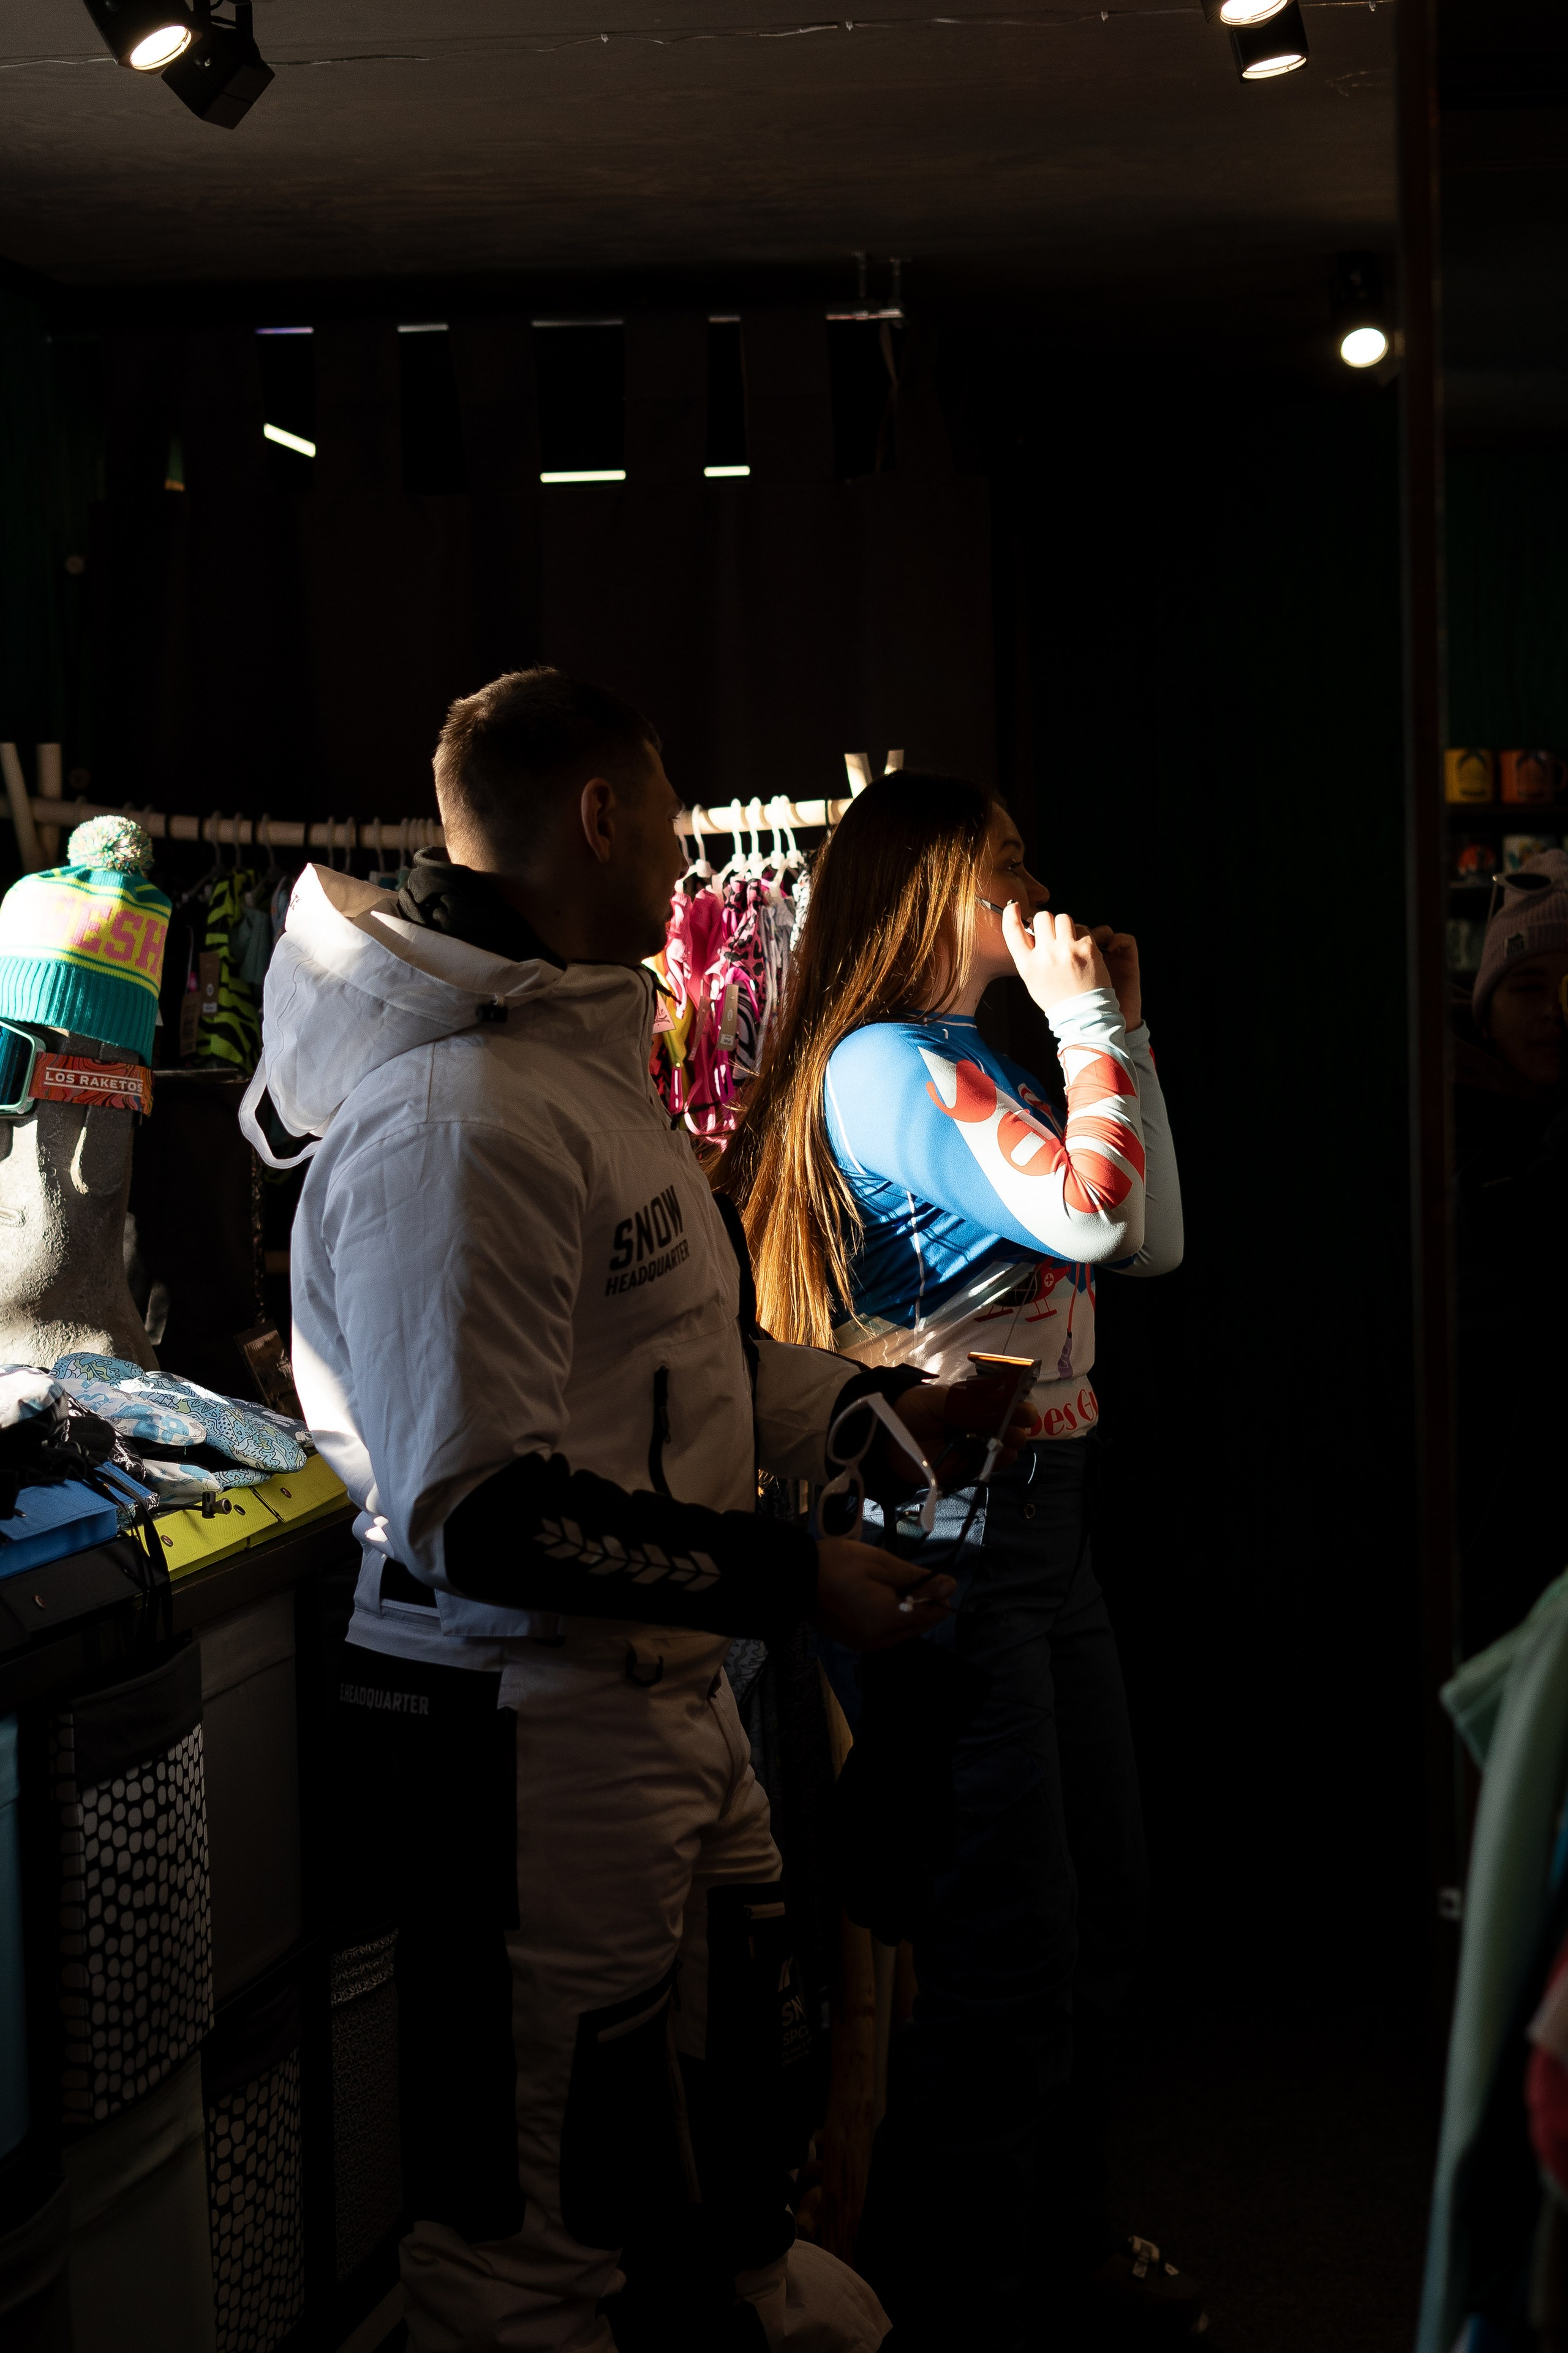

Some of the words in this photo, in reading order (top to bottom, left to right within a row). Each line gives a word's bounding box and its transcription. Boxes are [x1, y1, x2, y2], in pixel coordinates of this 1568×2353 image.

[45, 1071, 75, 1084] LOS
[80, 1075, 143, 1093] RAKETOS
[610, 1184, 683, 1271] SNOW
[605, 1239, 690, 1297] HEADQUARTER
